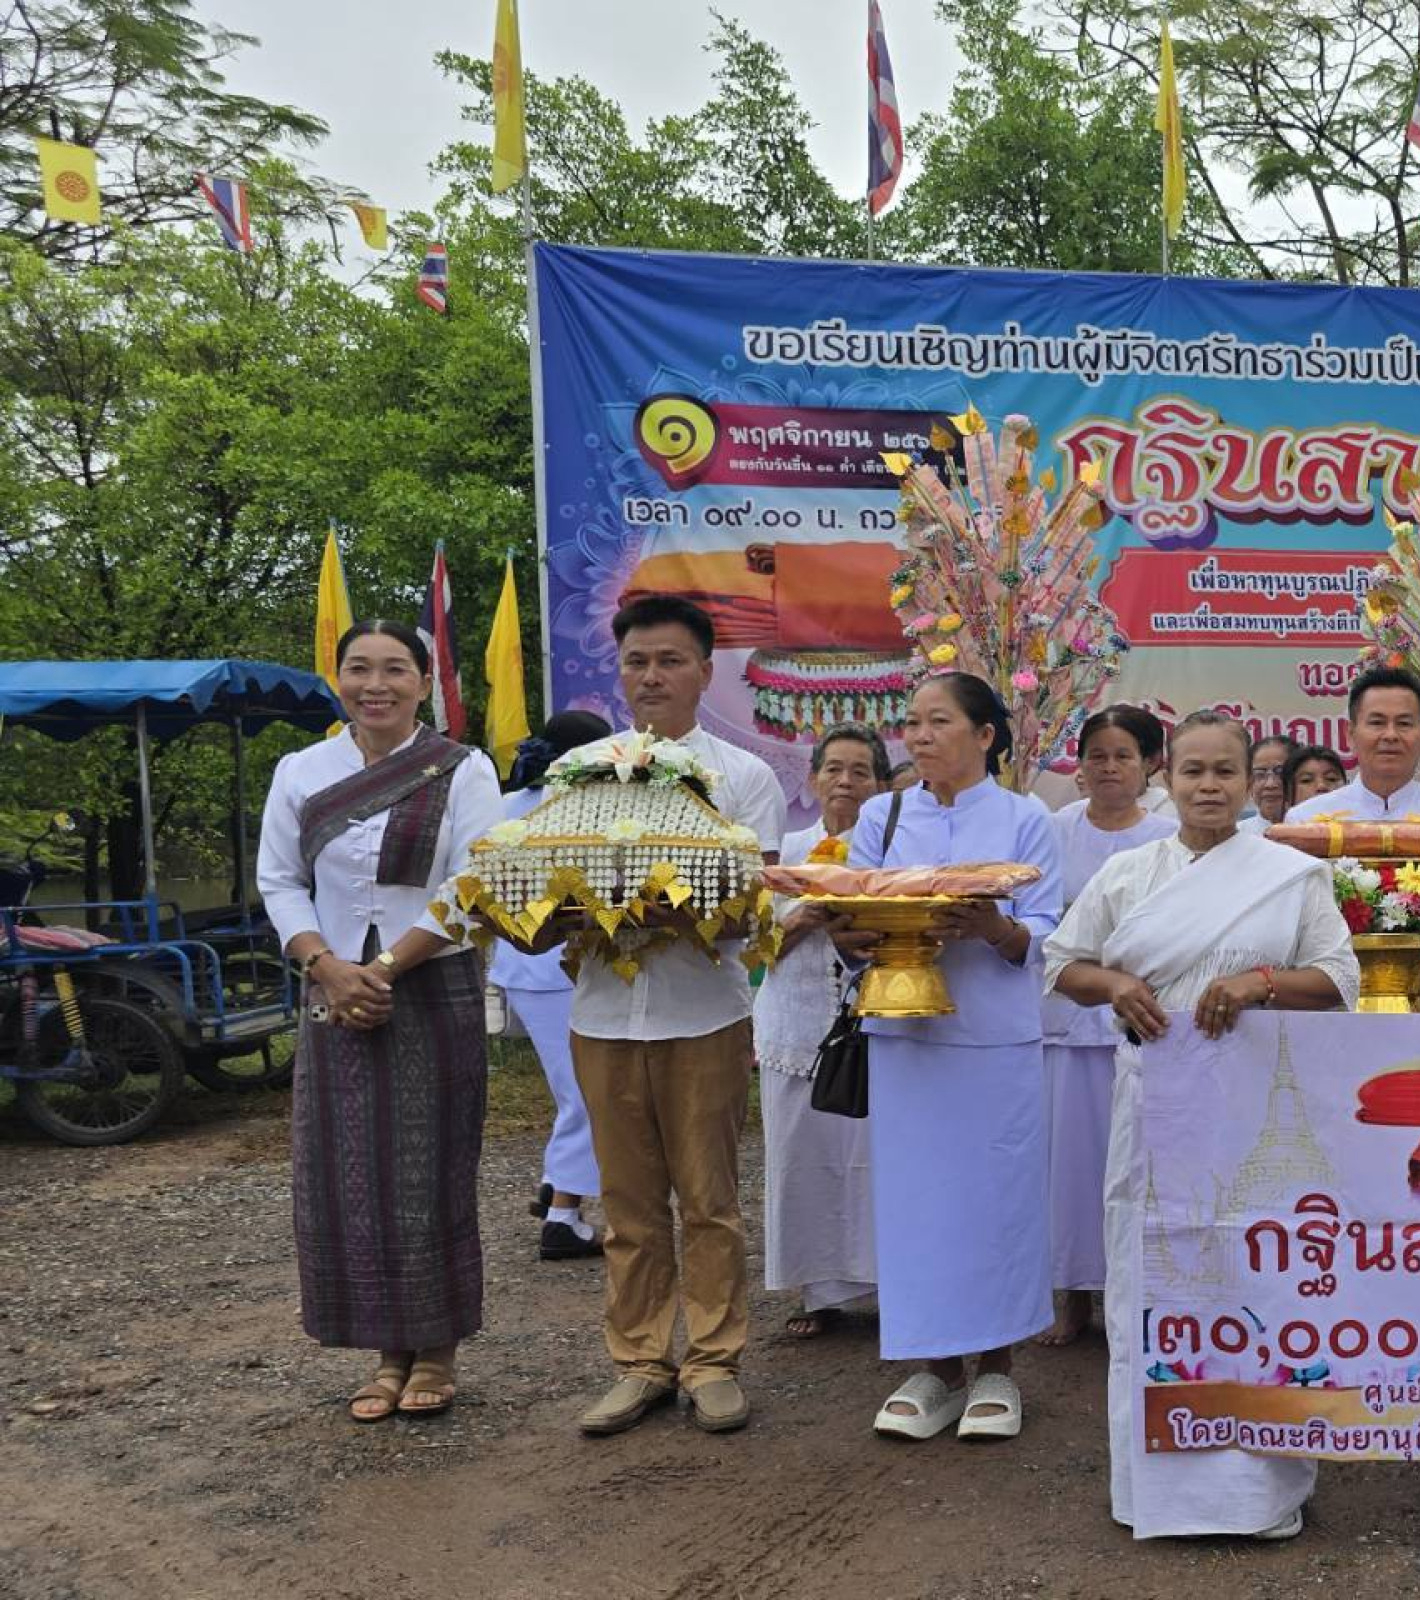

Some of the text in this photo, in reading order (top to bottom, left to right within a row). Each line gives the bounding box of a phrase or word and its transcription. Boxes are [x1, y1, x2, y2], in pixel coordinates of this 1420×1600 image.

[641, 399, 715, 474] ๑
[728, 420, 931, 451] พฤศจิกายน ๒๕๖
[625, 499, 897, 529] เวลา ๐๙.๐๐ น. ถว
[1190, 560, 1370, 598] เพื่อหาทุนบูรณปฏิ
[1153, 606, 1362, 636] และเพื่อสมทบทุนสร้างตึก
[1157, 1312, 1419, 1368] ๓๐,๐๐๐
